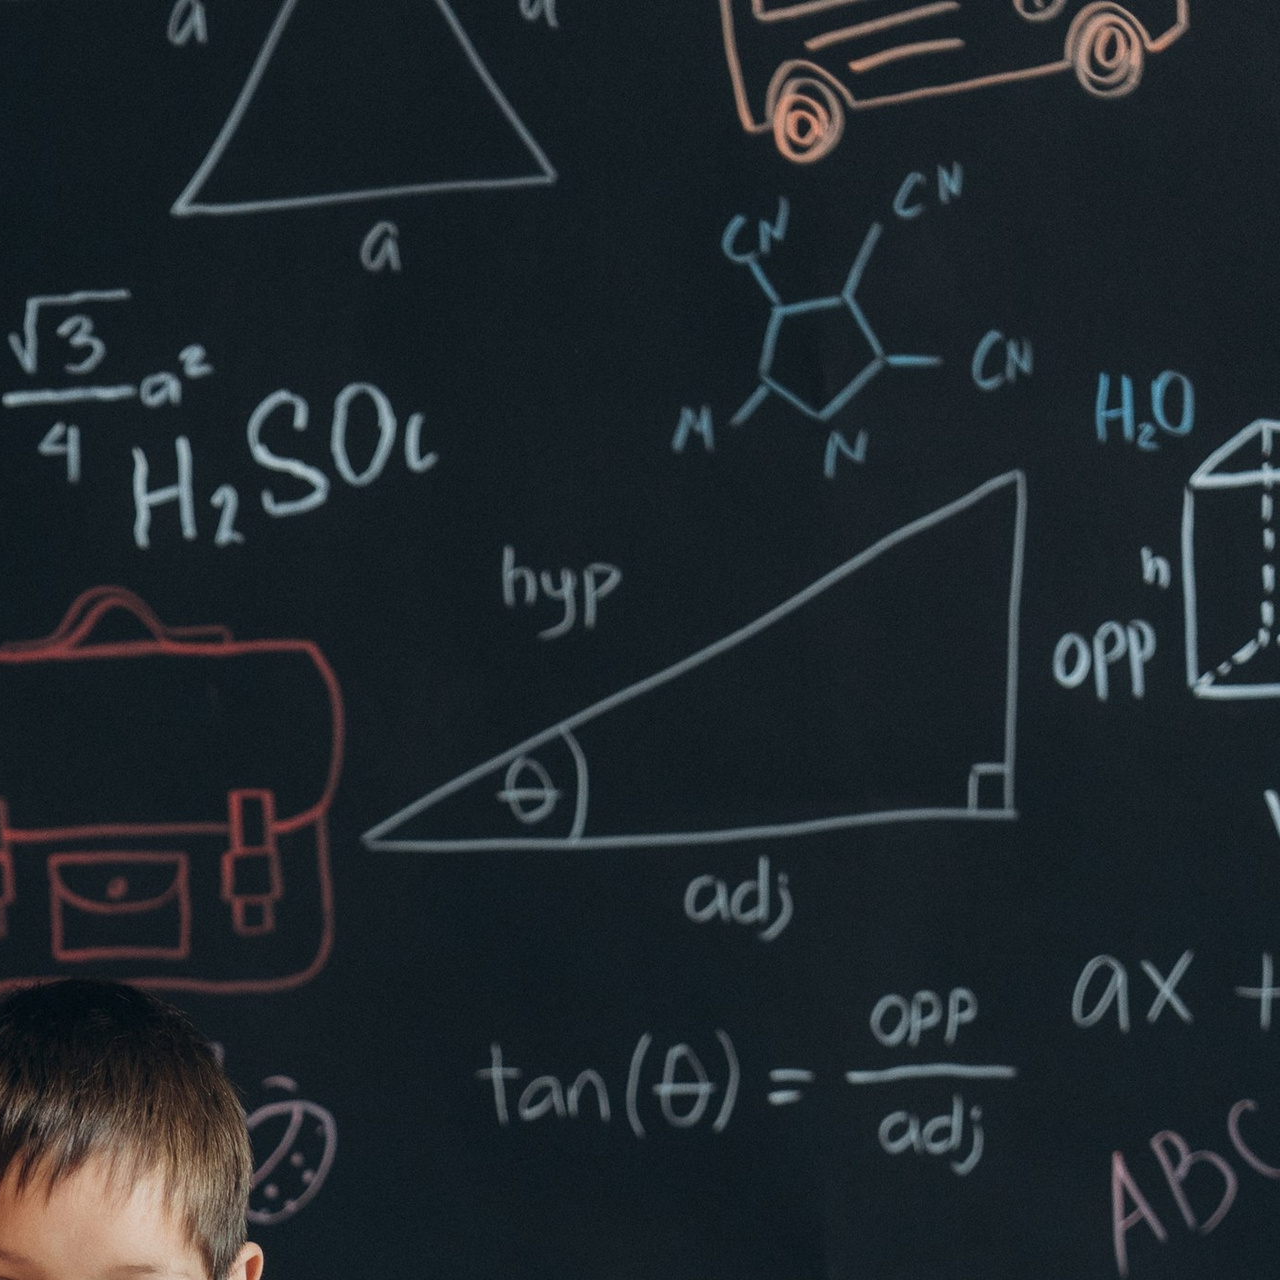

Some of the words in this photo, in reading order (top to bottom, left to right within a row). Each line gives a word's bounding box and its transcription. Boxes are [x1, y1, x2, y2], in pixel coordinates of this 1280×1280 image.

[167, 0, 208, 46] a
[892, 162, 964, 220] CN
[359, 220, 401, 272] a
[721, 197, 790, 263] CN
[970, 328, 1034, 392] CN
[38, 421, 81, 483] 4
[823, 430, 869, 479] N
[501, 545, 623, 639] hyp
[683, 854, 794, 941] adj
[877, 1094, 985, 1176] adj
